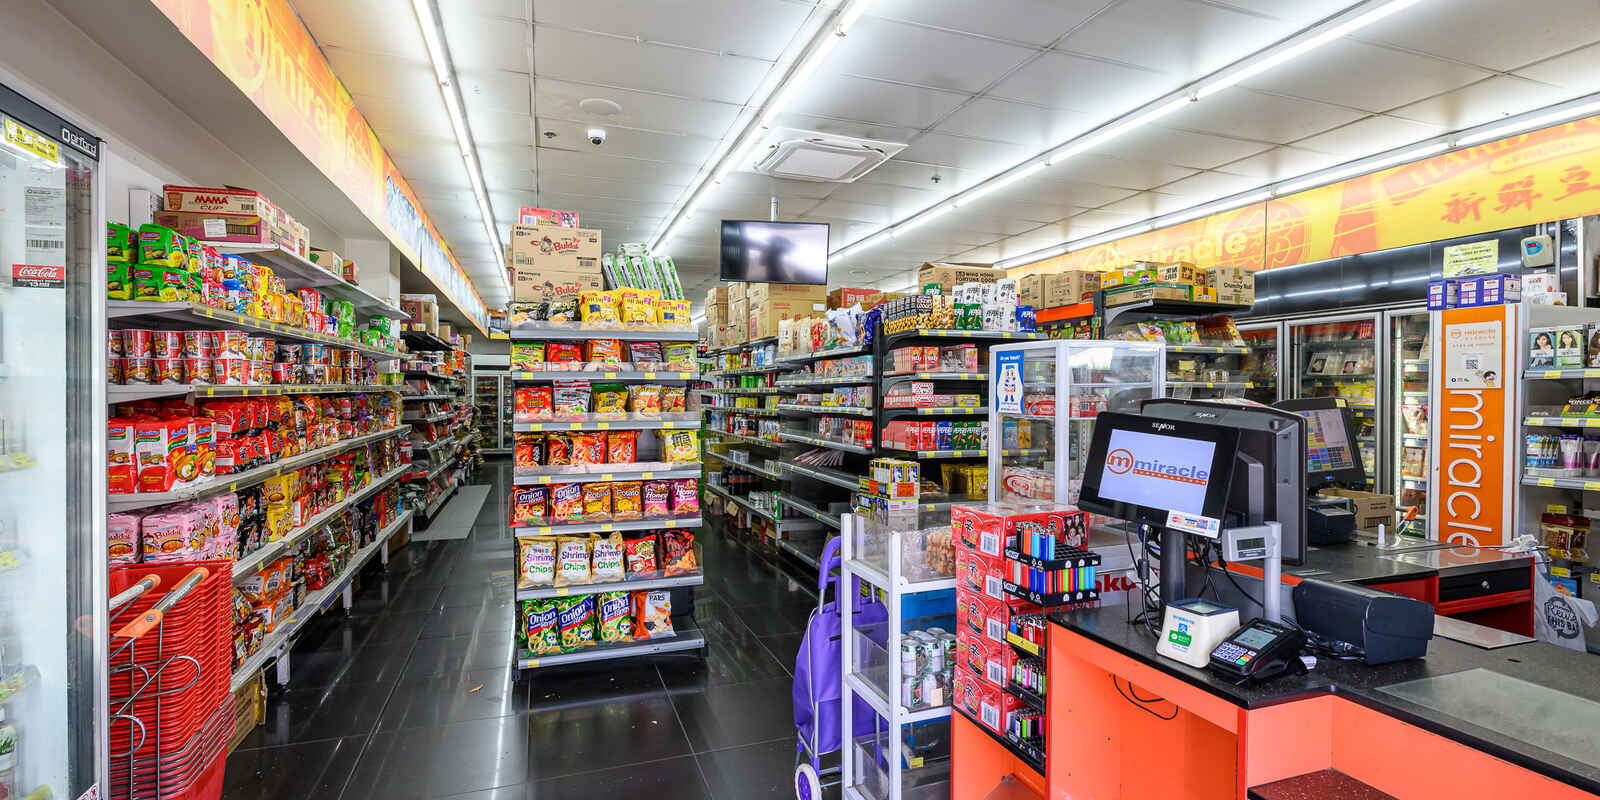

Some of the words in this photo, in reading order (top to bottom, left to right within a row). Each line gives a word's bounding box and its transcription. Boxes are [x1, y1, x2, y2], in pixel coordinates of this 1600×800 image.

[194, 194, 229, 205] MAMA
[18, 266, 57, 279] Coca-Cola
[1151, 422, 1176, 432] SENOR
[1134, 459, 1208, 480] miracle
[526, 553, 554, 562] Shrimp
[561, 551, 588, 560] Shrimp
[594, 549, 621, 558] Shrimp
[529, 564, 553, 574] Chips
[563, 562, 587, 571] Chips
[597, 561, 620, 569] Chips
[603, 598, 630, 615] Onion
[529, 611, 556, 625] Onion
[561, 604, 586, 624] Onion
